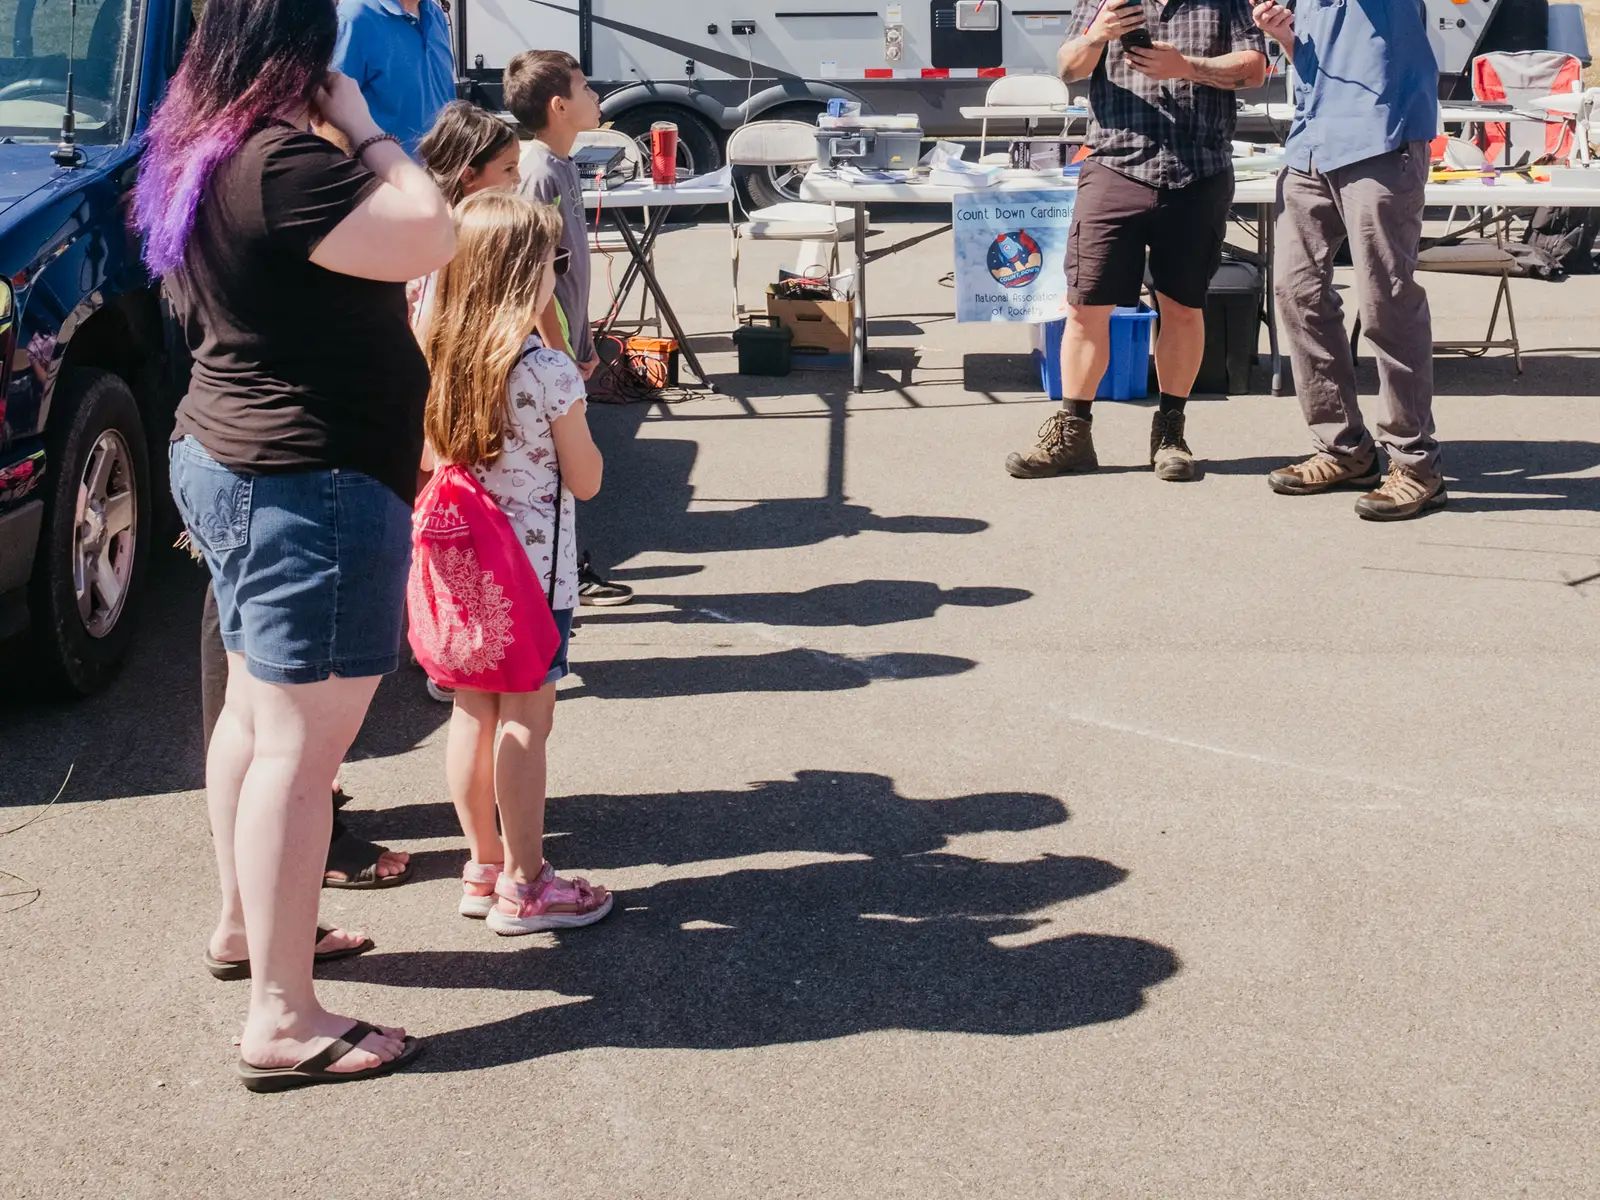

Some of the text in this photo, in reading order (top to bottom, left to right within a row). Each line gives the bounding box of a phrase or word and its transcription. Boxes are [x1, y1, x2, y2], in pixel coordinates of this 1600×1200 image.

[957, 207, 989, 221] Count
[995, 207, 1025, 219] Down
[975, 293, 1009, 303] National
[991, 305, 1003, 316] of
